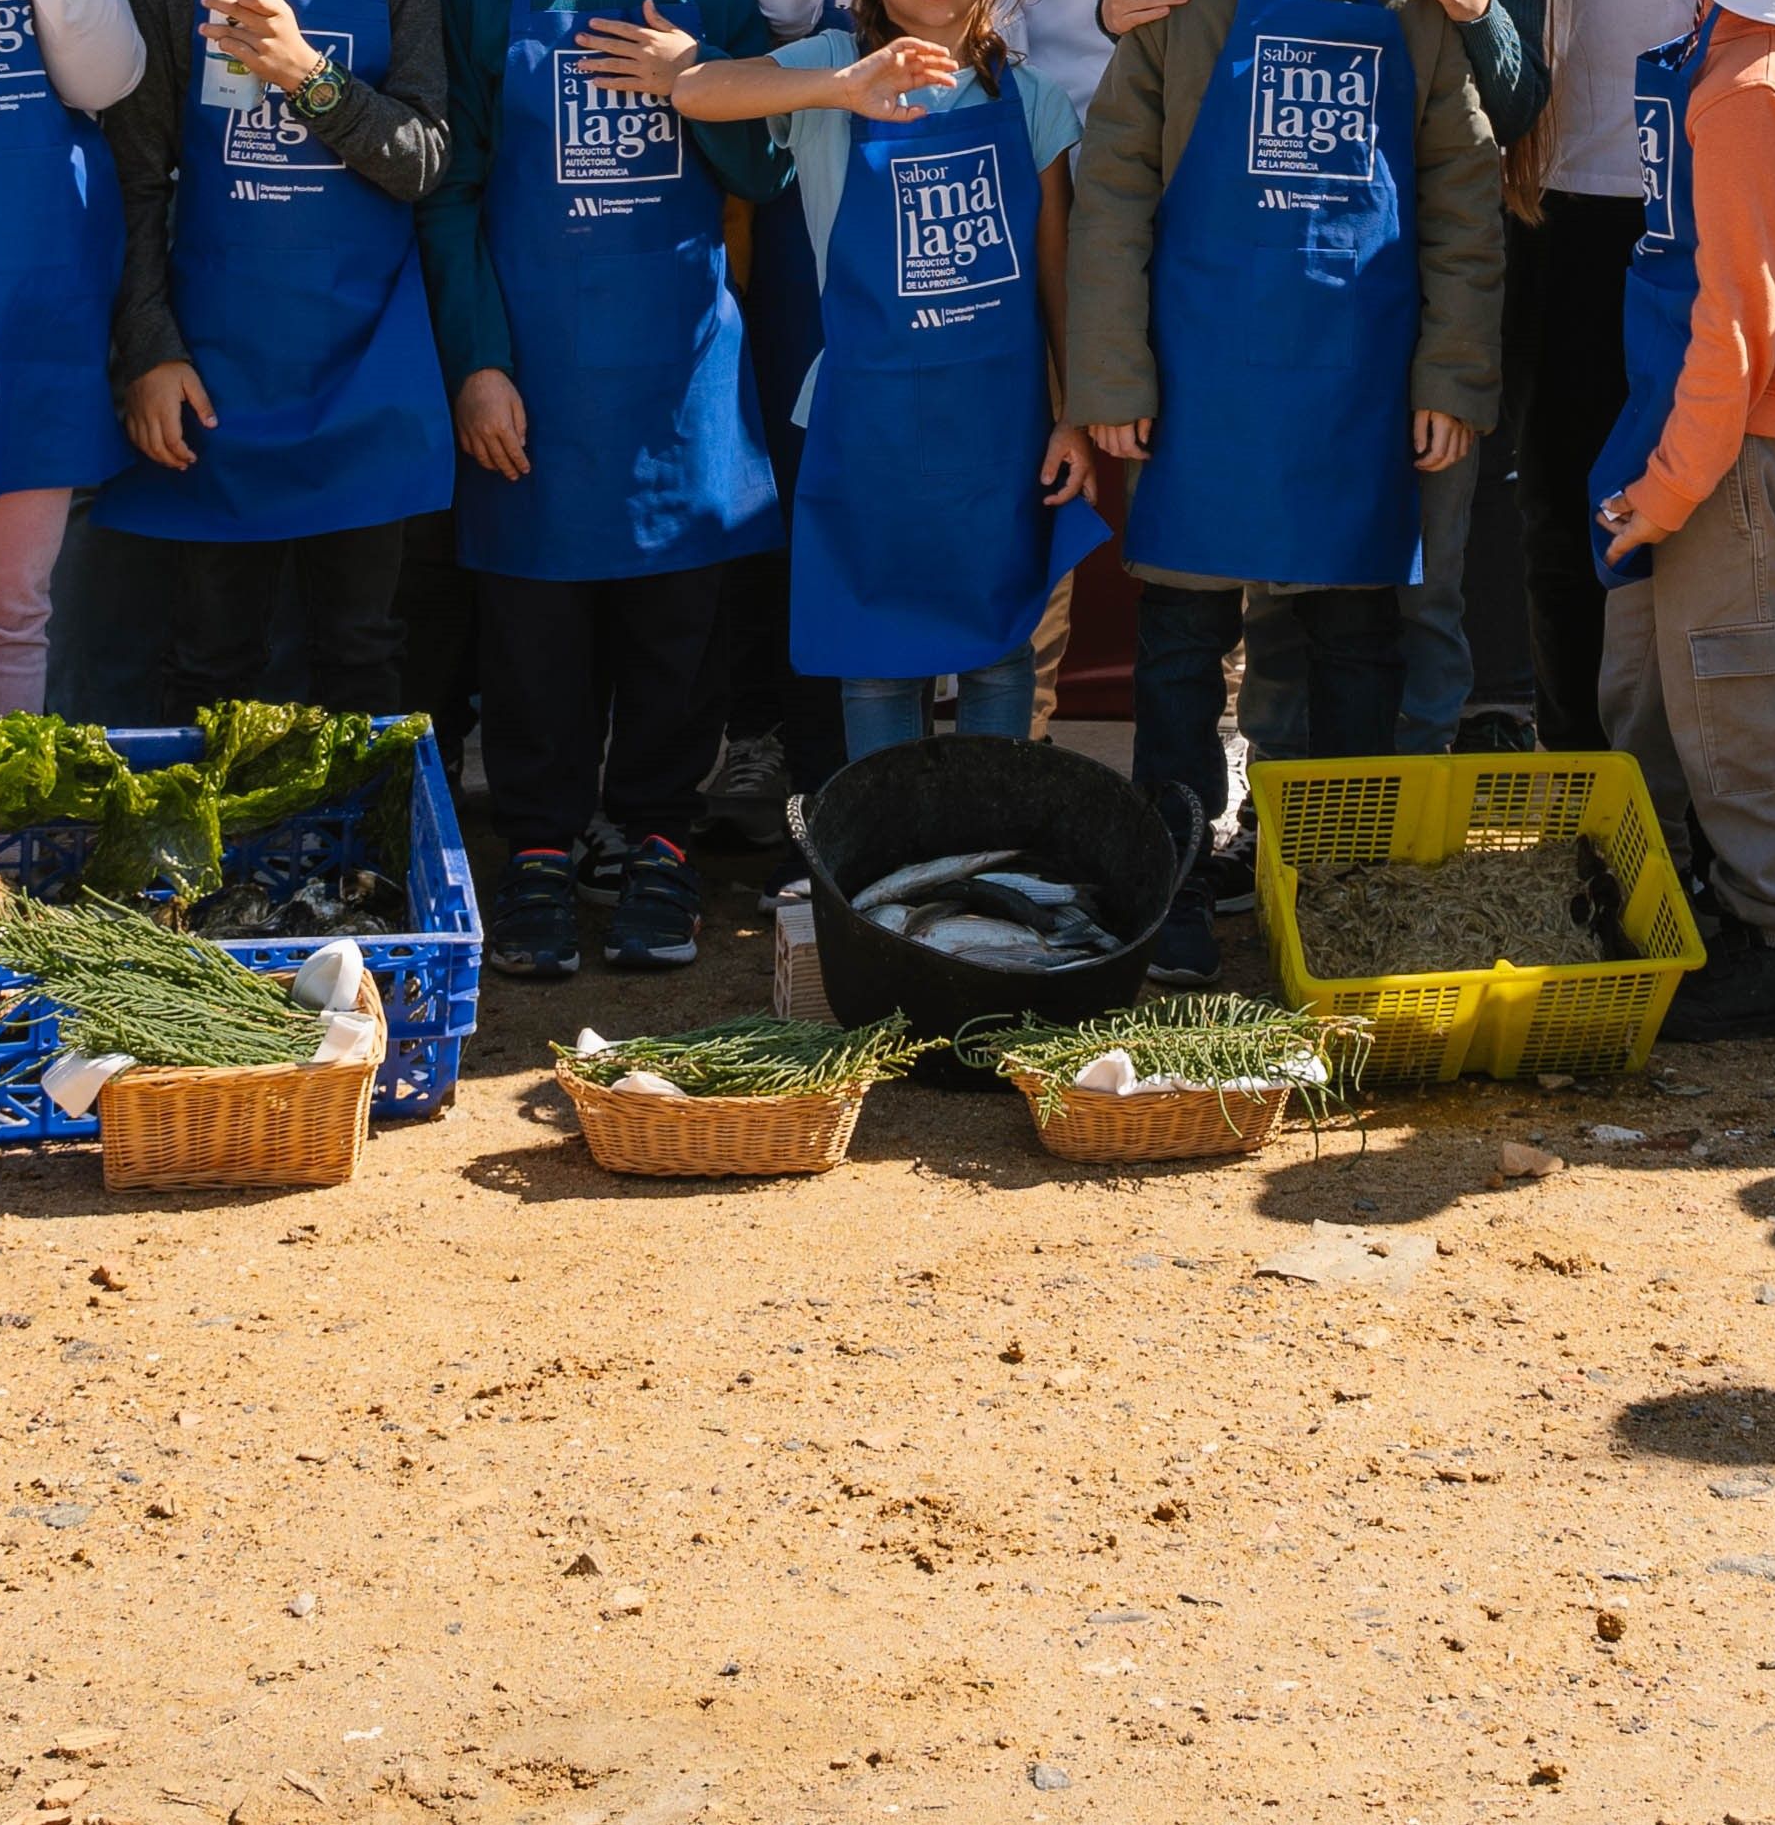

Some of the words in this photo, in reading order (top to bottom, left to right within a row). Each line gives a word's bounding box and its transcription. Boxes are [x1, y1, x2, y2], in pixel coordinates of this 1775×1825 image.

[1262, 43, 1317, 64] sabor
[564, 78, 580, 95] a
[1262, 65, 1277, 83] a
[1279, 55, 1370, 107] má
[565, 101, 675, 158] laga
[1259, 89, 1368, 153] laga
[898, 163, 950, 184] sabor
[903, 187, 915, 205] a
[918, 159, 996, 221] má
[906, 210, 1004, 266] laga
